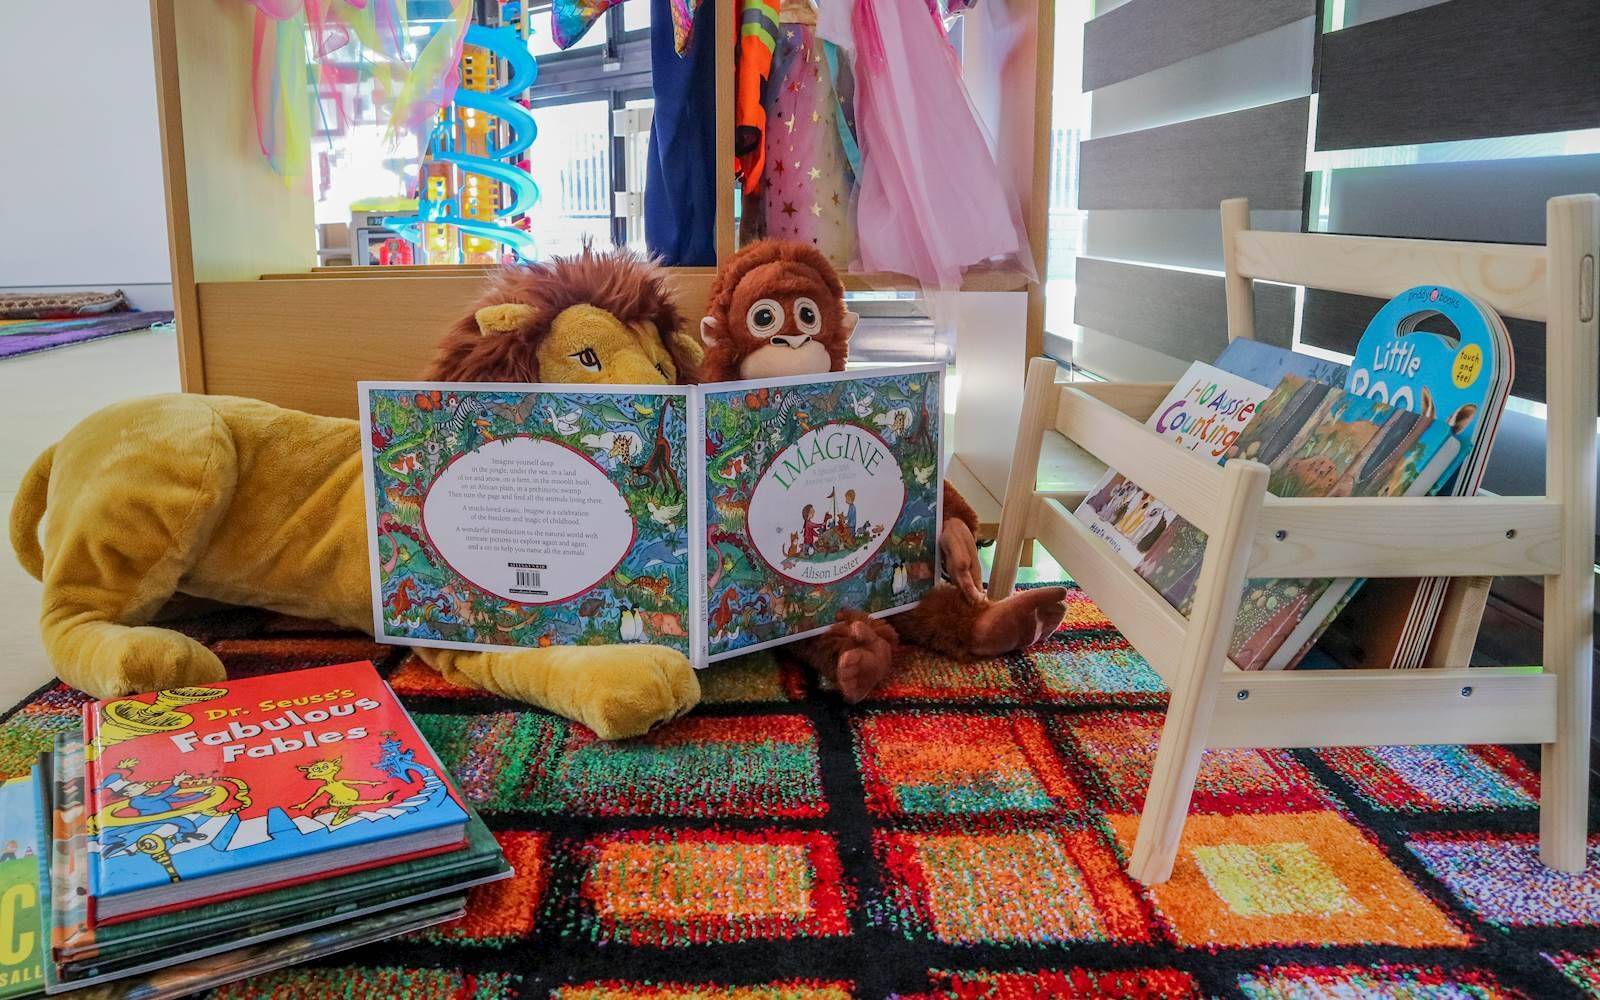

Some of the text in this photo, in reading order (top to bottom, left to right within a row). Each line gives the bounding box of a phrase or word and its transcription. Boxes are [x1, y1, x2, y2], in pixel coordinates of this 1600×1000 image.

[1373, 341, 1421, 378] Little
[1460, 350, 1479, 363] touch
[1459, 362, 1475, 373] and
[1456, 371, 1472, 383] feel
[1184, 379, 1218, 406] 1-10
[1155, 400, 1240, 457] Counting
[492, 458, 514, 467] Imagine
[516, 459, 539, 467] yourself
[772, 432, 884, 491] IMAGINE
[524, 507, 545, 515] Imagine
[557, 509, 589, 517] celebration
[490, 536, 512, 544] pictures
[491, 528, 526, 536] introduction
[501, 545, 514, 553] help
[801, 557, 859, 579] Alison Lester
[204, 689, 356, 721] Dr. Seuss's
[170, 697, 382, 754] Fabulous
[222, 726, 369, 763] Fables
